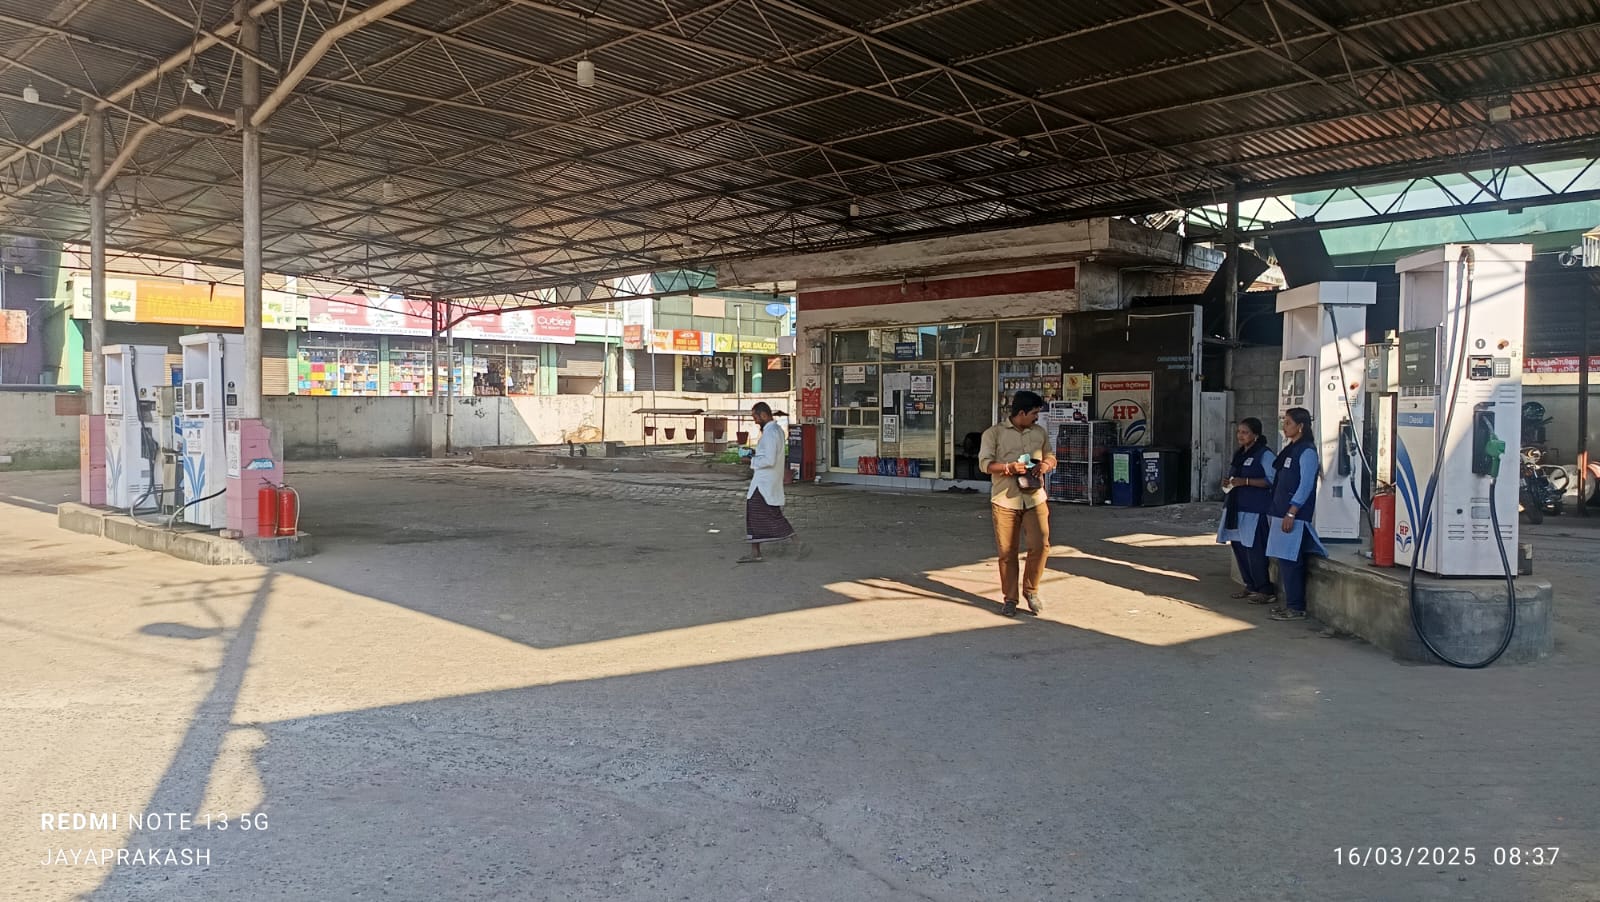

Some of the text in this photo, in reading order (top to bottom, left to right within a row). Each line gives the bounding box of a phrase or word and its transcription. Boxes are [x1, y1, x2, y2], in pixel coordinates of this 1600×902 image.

[1113, 405, 1139, 420] HP
[1409, 415, 1424, 424] Diesel
[1400, 525, 1409, 535] HP
